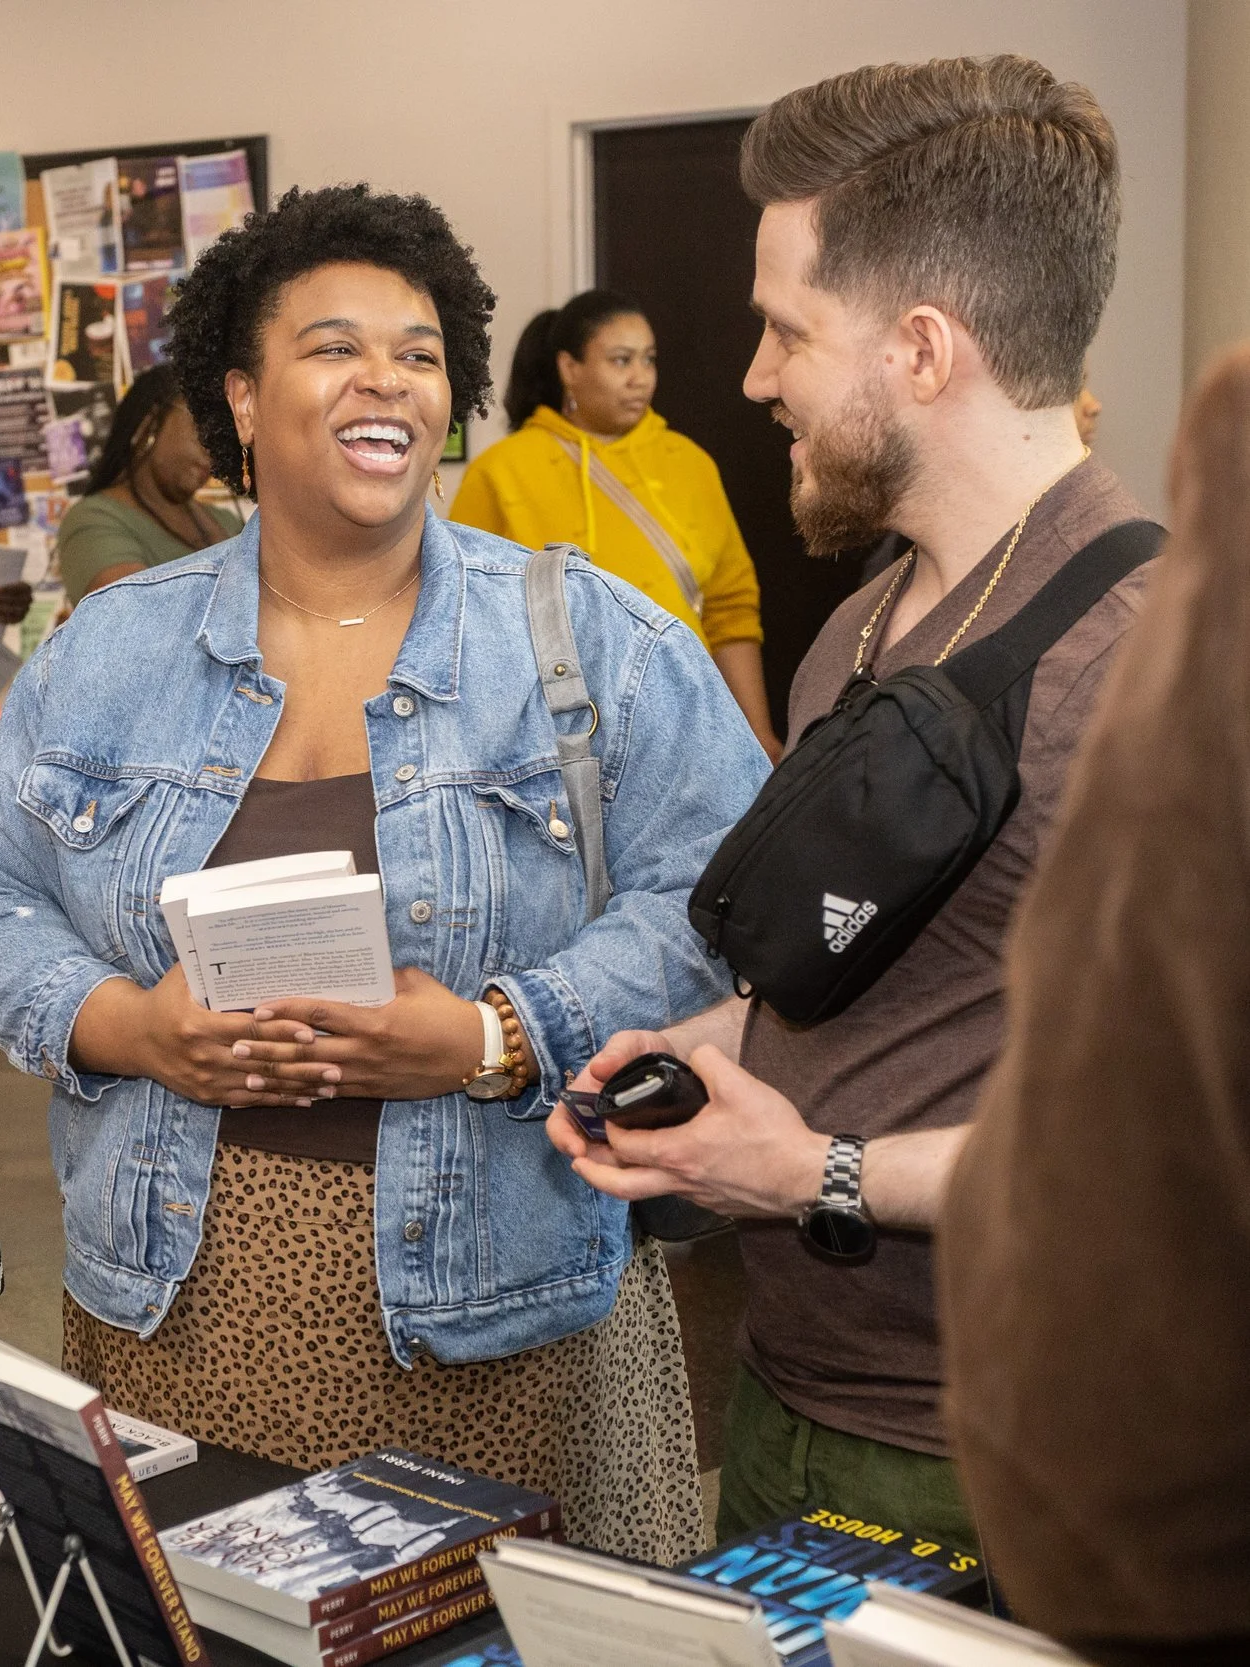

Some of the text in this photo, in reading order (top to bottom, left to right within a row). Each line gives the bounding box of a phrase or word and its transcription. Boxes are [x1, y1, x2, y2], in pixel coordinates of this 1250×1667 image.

[828, 900, 878, 953] adidas
[132, 1464, 158, 1479] LUES
[377, 1453, 466, 1486] IMANI PERRY
[115, 1472, 140, 1511] MAY
[130, 1511, 151, 1540] WE
[141, 1536, 180, 1613] FOREVER
[171, 1610, 200, 1663] STAND
[801, 1508, 978, 1572] S. D. HOUSE
[321, 1597, 345, 1614] PERRY
[370, 1575, 397, 1597] MAY
[399, 1565, 421, 1584] WE
[421, 1543, 477, 1575] FOREVER
[329, 1624, 354, 1640] PERRY
[378, 1601, 404, 1622] MAY
[406, 1590, 428, 1609] WE
[428, 1567, 482, 1600] FOREVER
[334, 1651, 359, 1667] PERRY
[382, 1627, 408, 1650] MAY
[410, 1617, 432, 1637] WE
[432, 1595, 486, 1627] FOREVER
